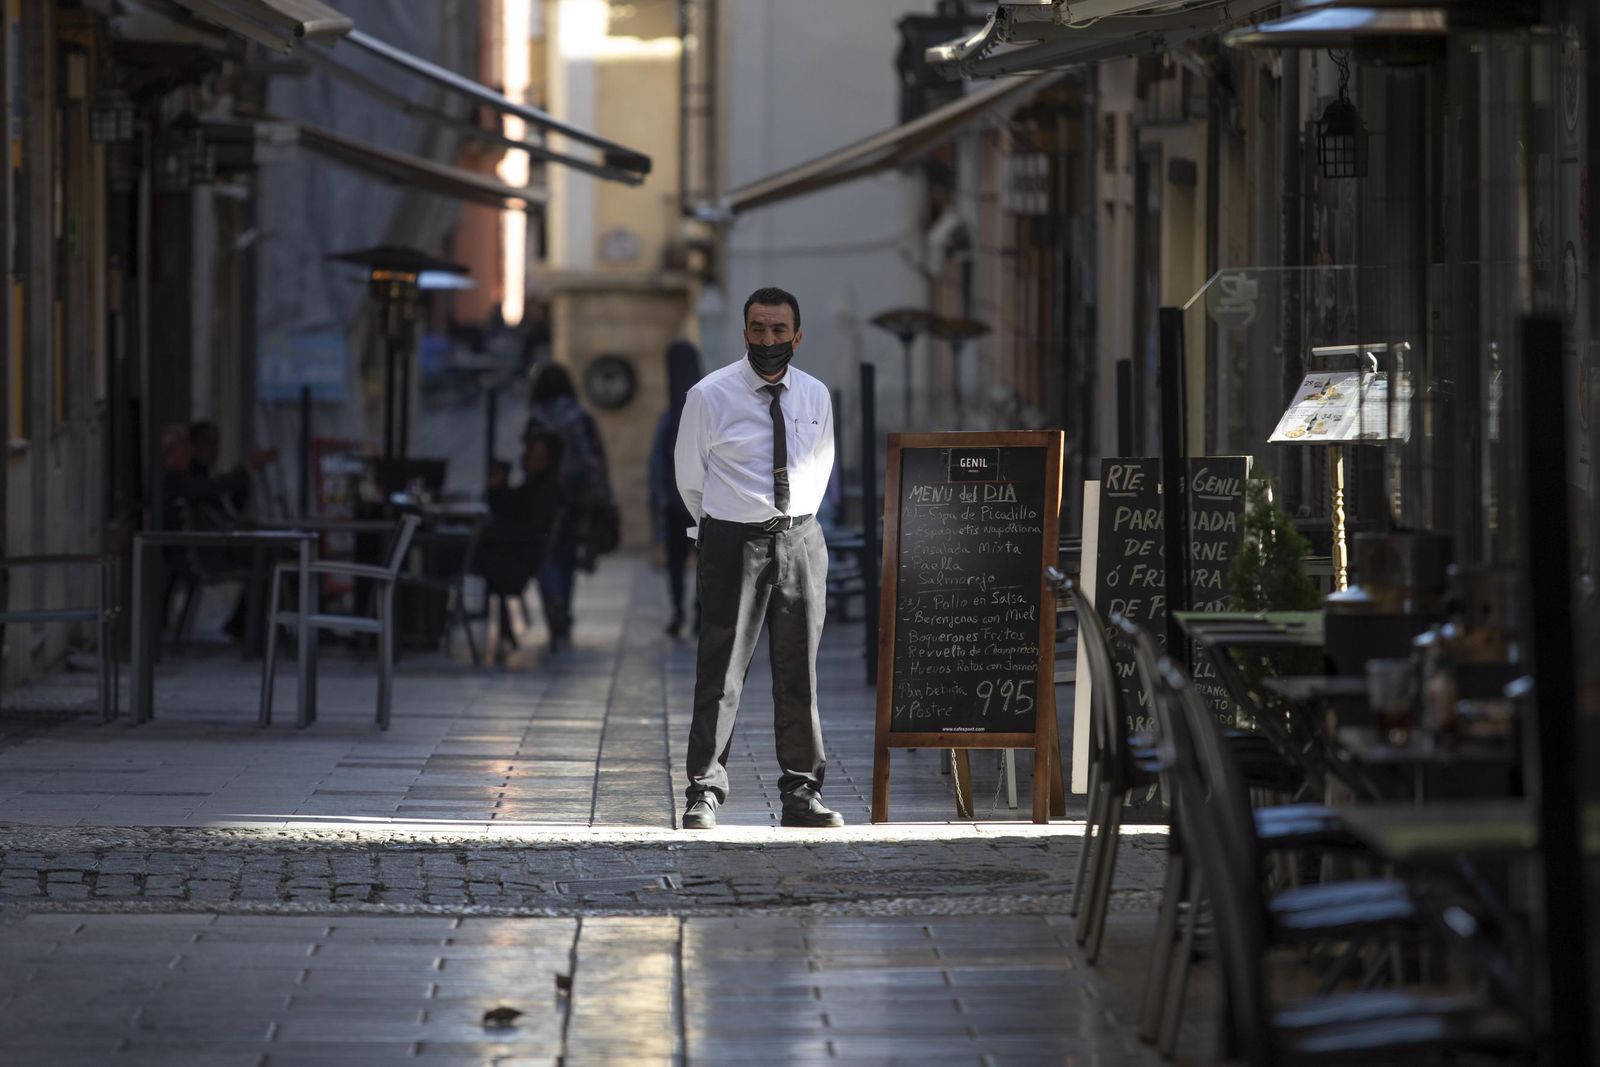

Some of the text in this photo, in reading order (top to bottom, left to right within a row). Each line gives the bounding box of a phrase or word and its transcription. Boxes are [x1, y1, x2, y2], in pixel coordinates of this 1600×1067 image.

[960, 458, 988, 468] GENIL
[1106, 464, 1242, 496] RTE. GENIL
[909, 485, 953, 503] MENU
[959, 485, 977, 501] del
[928, 506, 958, 525] Sopa
[961, 506, 976, 520] de
[981, 505, 1037, 521] Picadillo
[979, 540, 1022, 554] Mixta
[1124, 538, 1155, 557] DE
[911, 555, 964, 571] Paella
[933, 594, 968, 610] Pollo
[974, 596, 987, 606] en
[991, 591, 1027, 605] Salsa
[1108, 598, 1142, 618] DE
[914, 605, 1036, 628] Berenjenas con Miel
[980, 627, 1025, 641] Fritos
[969, 646, 981, 656] de
[910, 661, 951, 675] Huevos
[956, 659, 984, 672] Rotos
[986, 663, 1002, 671] con
[909, 700, 953, 719] Postre
